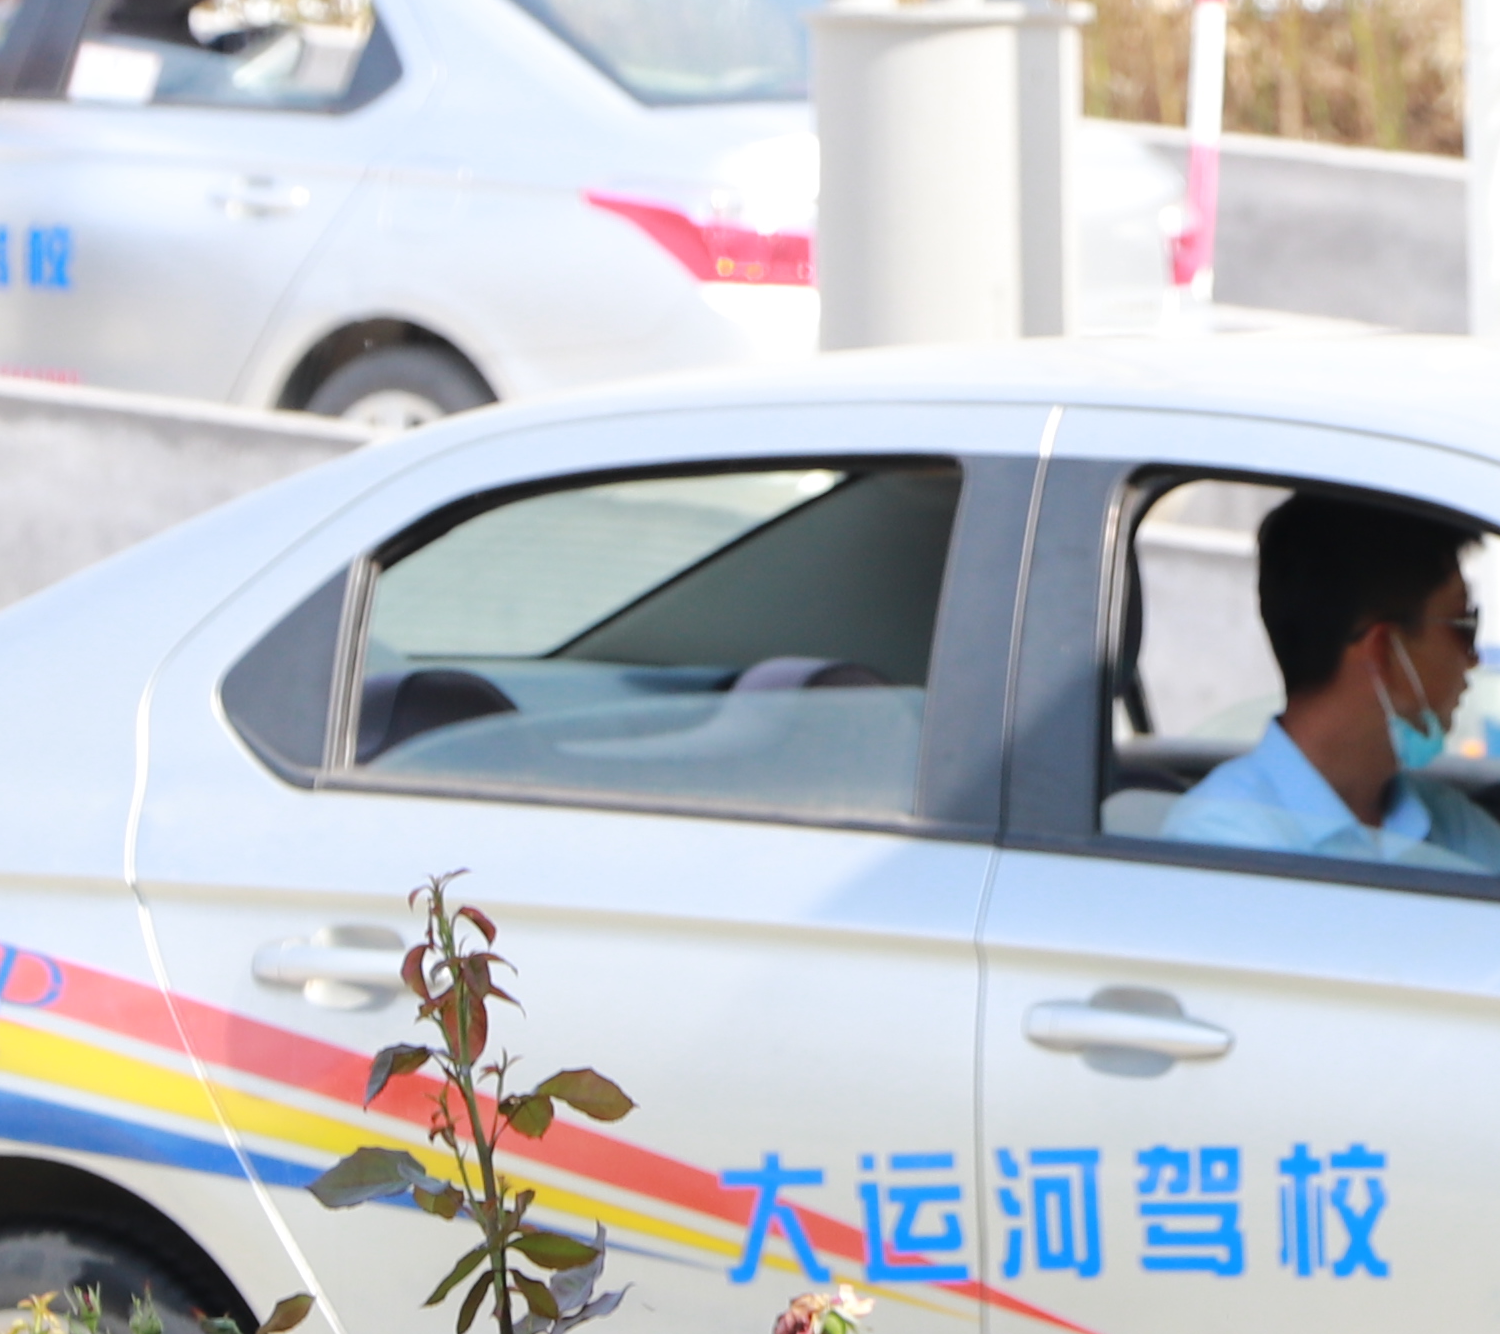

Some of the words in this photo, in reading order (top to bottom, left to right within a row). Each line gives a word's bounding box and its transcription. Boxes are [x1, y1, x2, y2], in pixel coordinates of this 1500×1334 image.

[719, 1142, 1392, 1284] 大运河驾校
